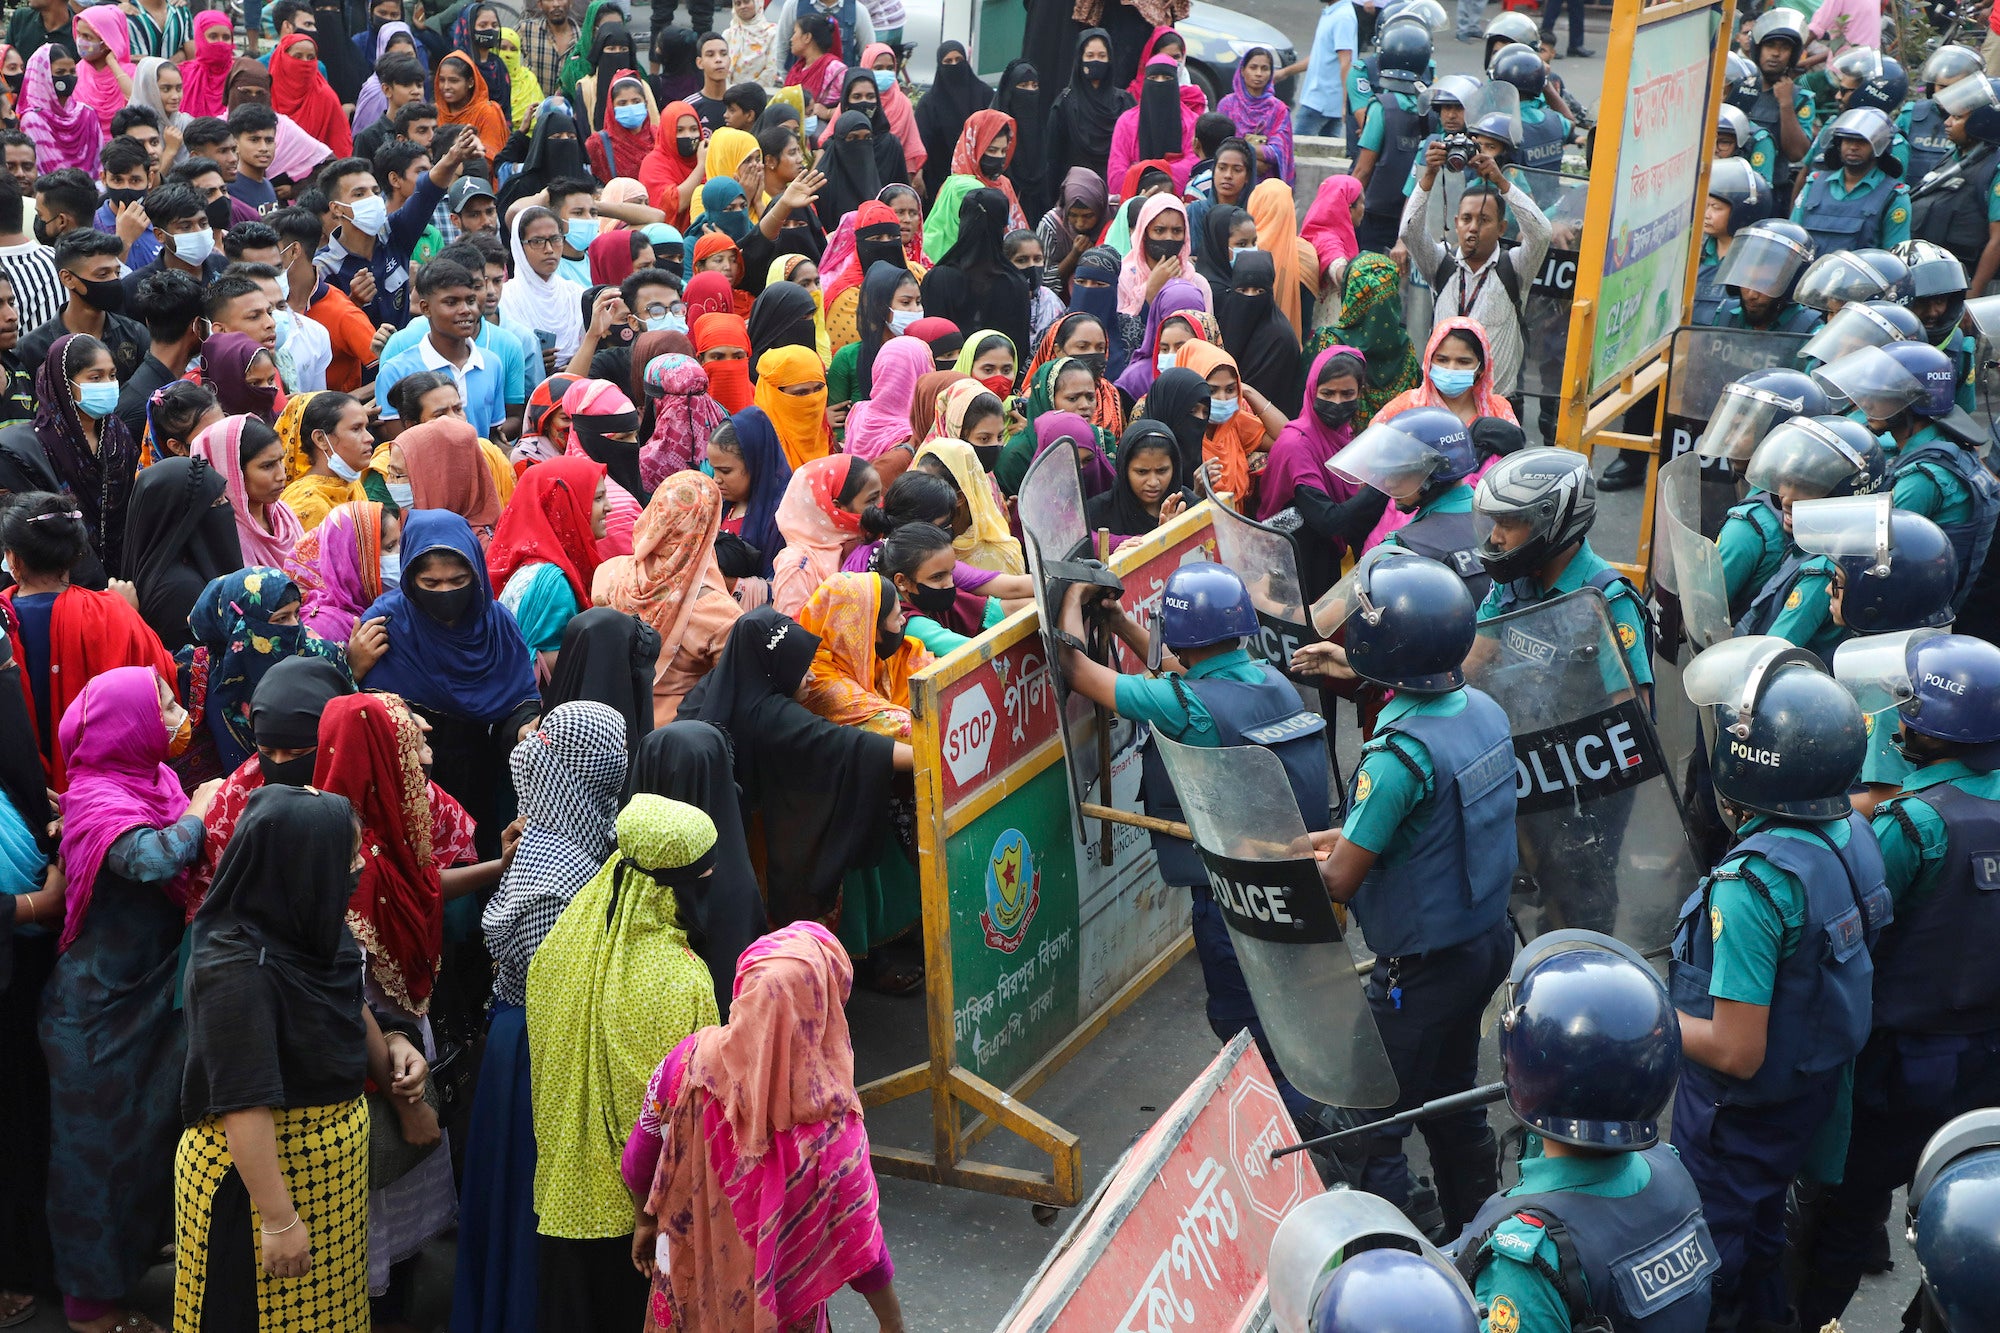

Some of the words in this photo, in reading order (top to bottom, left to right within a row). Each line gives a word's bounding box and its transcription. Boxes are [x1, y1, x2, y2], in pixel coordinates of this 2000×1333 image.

[1865, 83, 1890, 102] POLICE
[1527, 142, 1562, 161] POLICE
[1913, 136, 1955, 149] POLIC
[1927, 372, 1951, 381] POLICE
[1440, 431, 1466, 446] POLICE
[1853, 474, 1883, 496] POLICE
[1165, 597, 1189, 610] POLICE
[1249, 625, 1299, 668] ICE
[1510, 632, 1549, 661] POLICE
[1924, 672, 1966, 696] POLICE
[1004, 653, 1052, 747] পুলি
[949, 710, 991, 762] STOP
[1252, 711, 1320, 743] POLICE
[1516, 721, 1643, 799] OLICE
[1731, 740, 1781, 768] POLICE
[1111, 758, 1132, 779] Smart
[998, 956, 1036, 1008] মিরপুর
[1029, 984, 1056, 1023] ঢাকা
[1114, 1156, 1239, 1333] কপোস্ট
[1495, 1233, 1531, 1253] পুলিশ
[1641, 1240, 1697, 1291] POLICE
